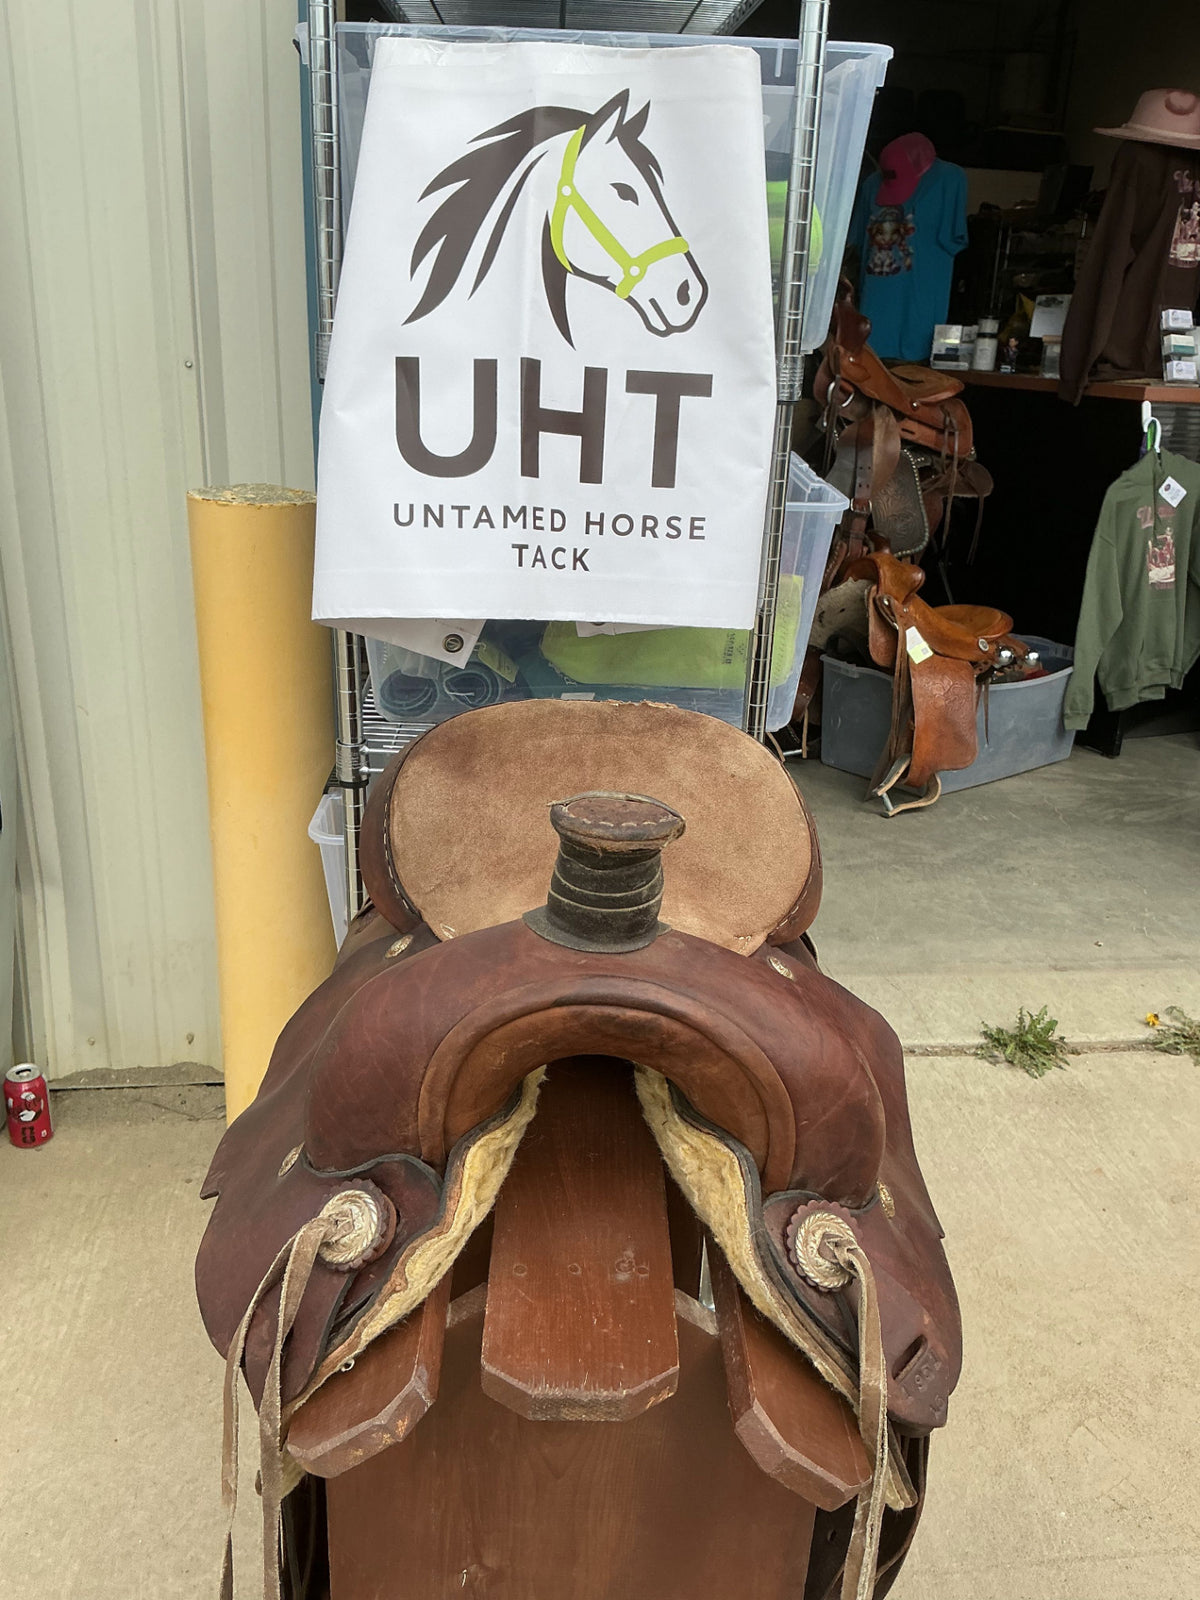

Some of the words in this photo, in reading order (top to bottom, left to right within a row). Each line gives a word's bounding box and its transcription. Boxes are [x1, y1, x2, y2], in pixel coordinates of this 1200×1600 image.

[395, 356, 714, 489] UHT
[393, 503, 567, 533] UNTAMED
[584, 511, 706, 540] HORSE
[511, 543, 590, 572] TACK
